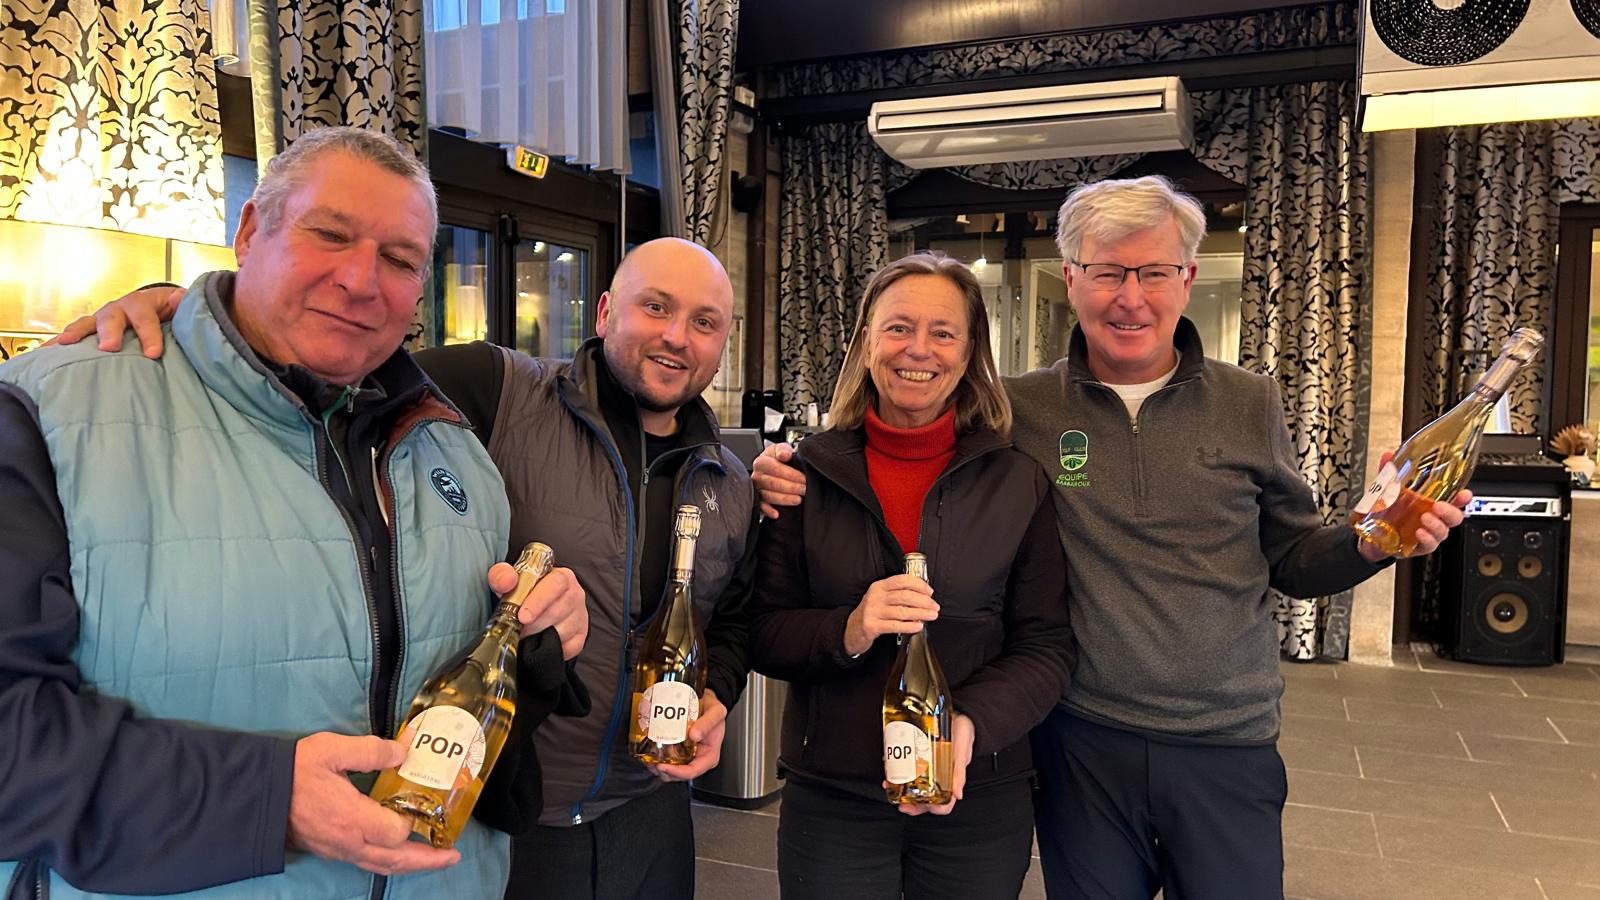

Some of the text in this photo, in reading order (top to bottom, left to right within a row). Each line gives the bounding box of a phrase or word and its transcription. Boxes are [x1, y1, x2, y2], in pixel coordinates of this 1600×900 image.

[654, 705, 686, 720] POP
[415, 733, 464, 759] POP
[887, 745, 912, 760] POP
